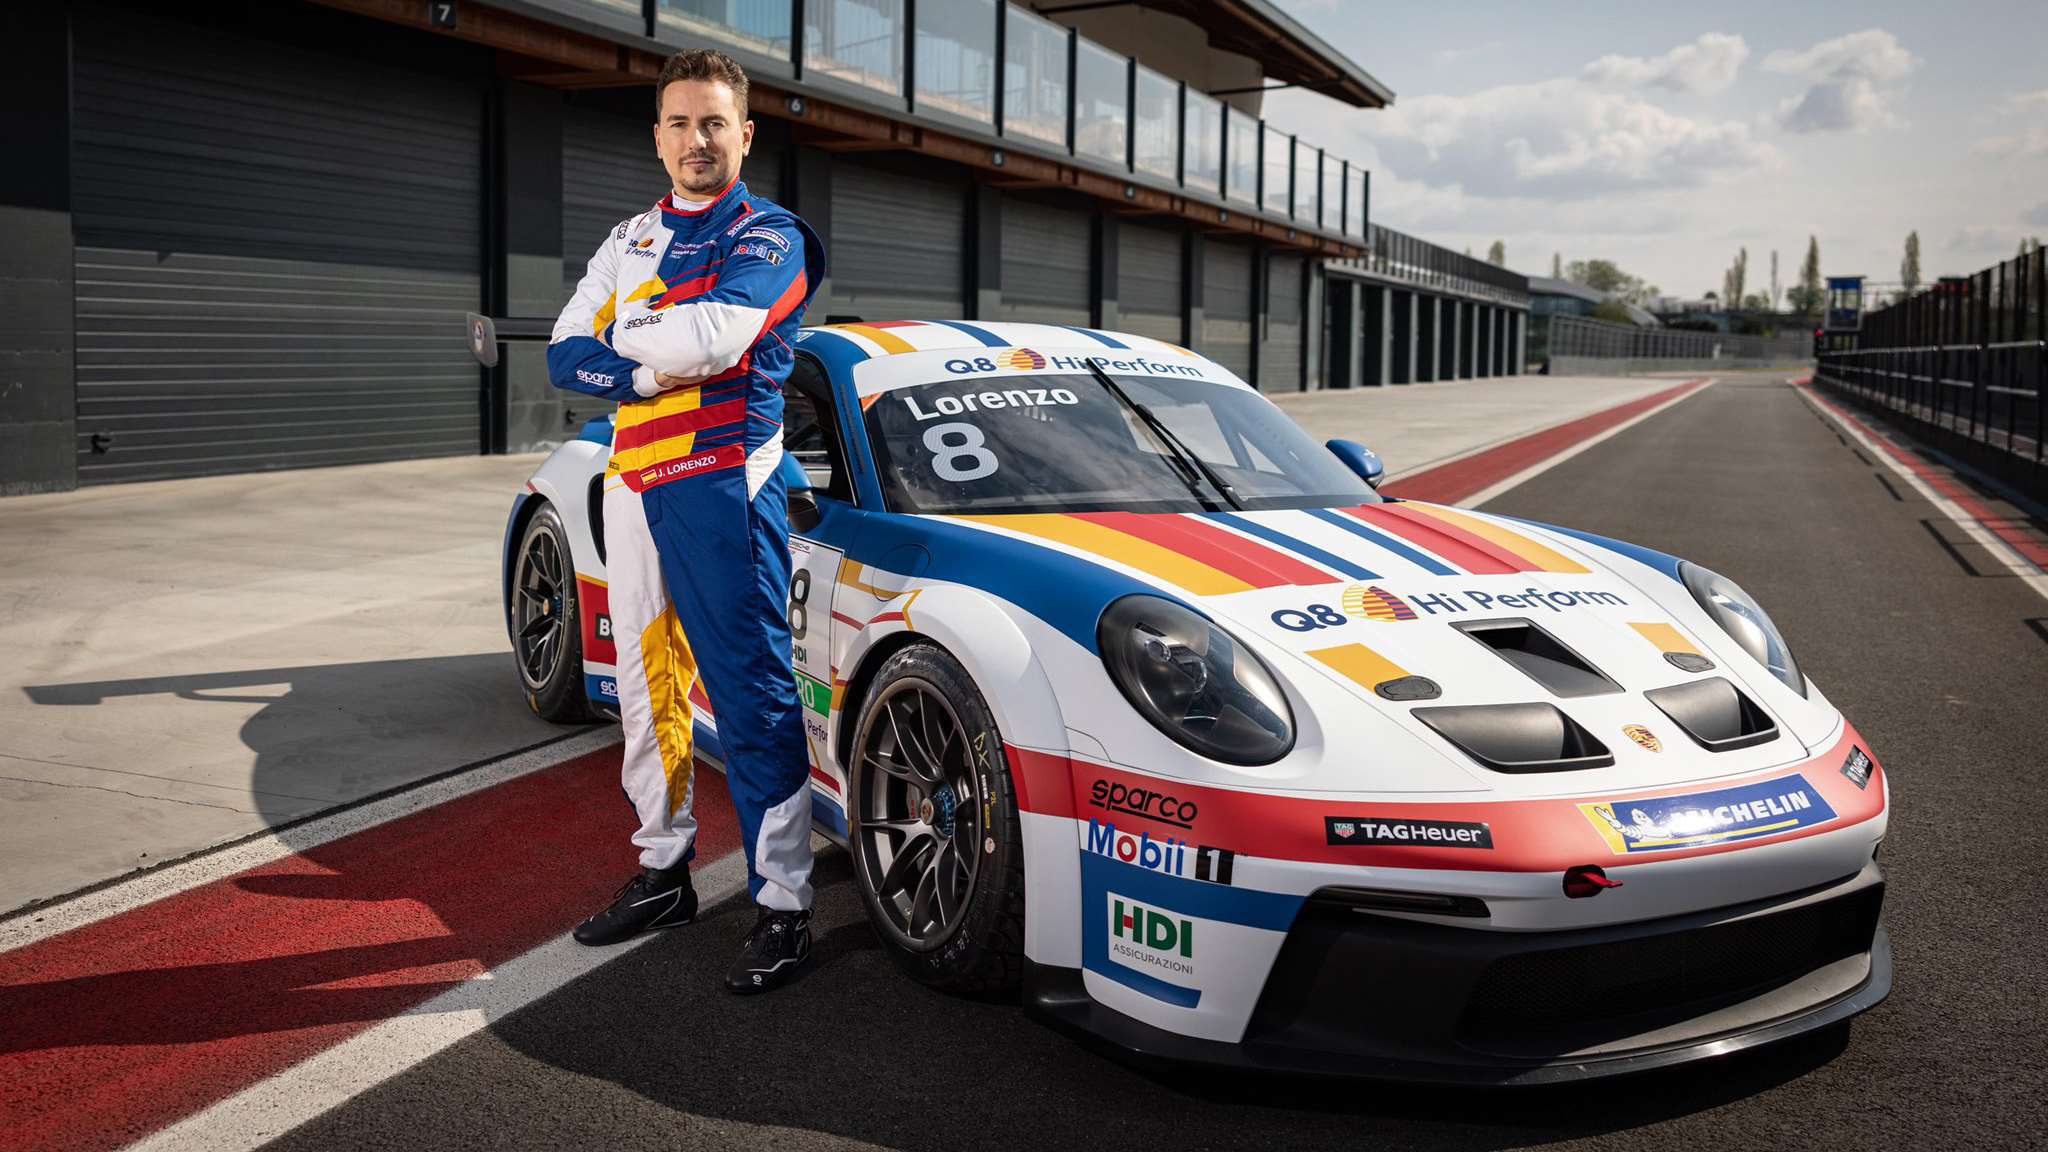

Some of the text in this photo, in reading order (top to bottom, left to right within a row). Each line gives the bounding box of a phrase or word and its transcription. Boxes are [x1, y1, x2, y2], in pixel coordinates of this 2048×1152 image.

[438, 3, 450, 21] 7
[791, 99, 801, 112] 6
[727, 211, 767, 238] spar
[944, 356, 1204, 378] Q8 Hi Perform
[903, 388, 1079, 421] Lorenzo
[656, 455, 717, 478] J. LORENZO
[922, 422, 999, 482] 8
[788, 567, 811, 641] 8
[1270, 588, 1629, 632] Q8 Hi Perform
[792, 645, 807, 664] HDI
[795, 674, 815, 709] RO
[807, 719, 828, 743] Perfor
[1090, 779, 1198, 826] sparco
[1088, 816, 1185, 876] Mobil
[1113, 900, 1193, 958] HDI
[1113, 943, 1193, 975] ASSICURAZIONI
